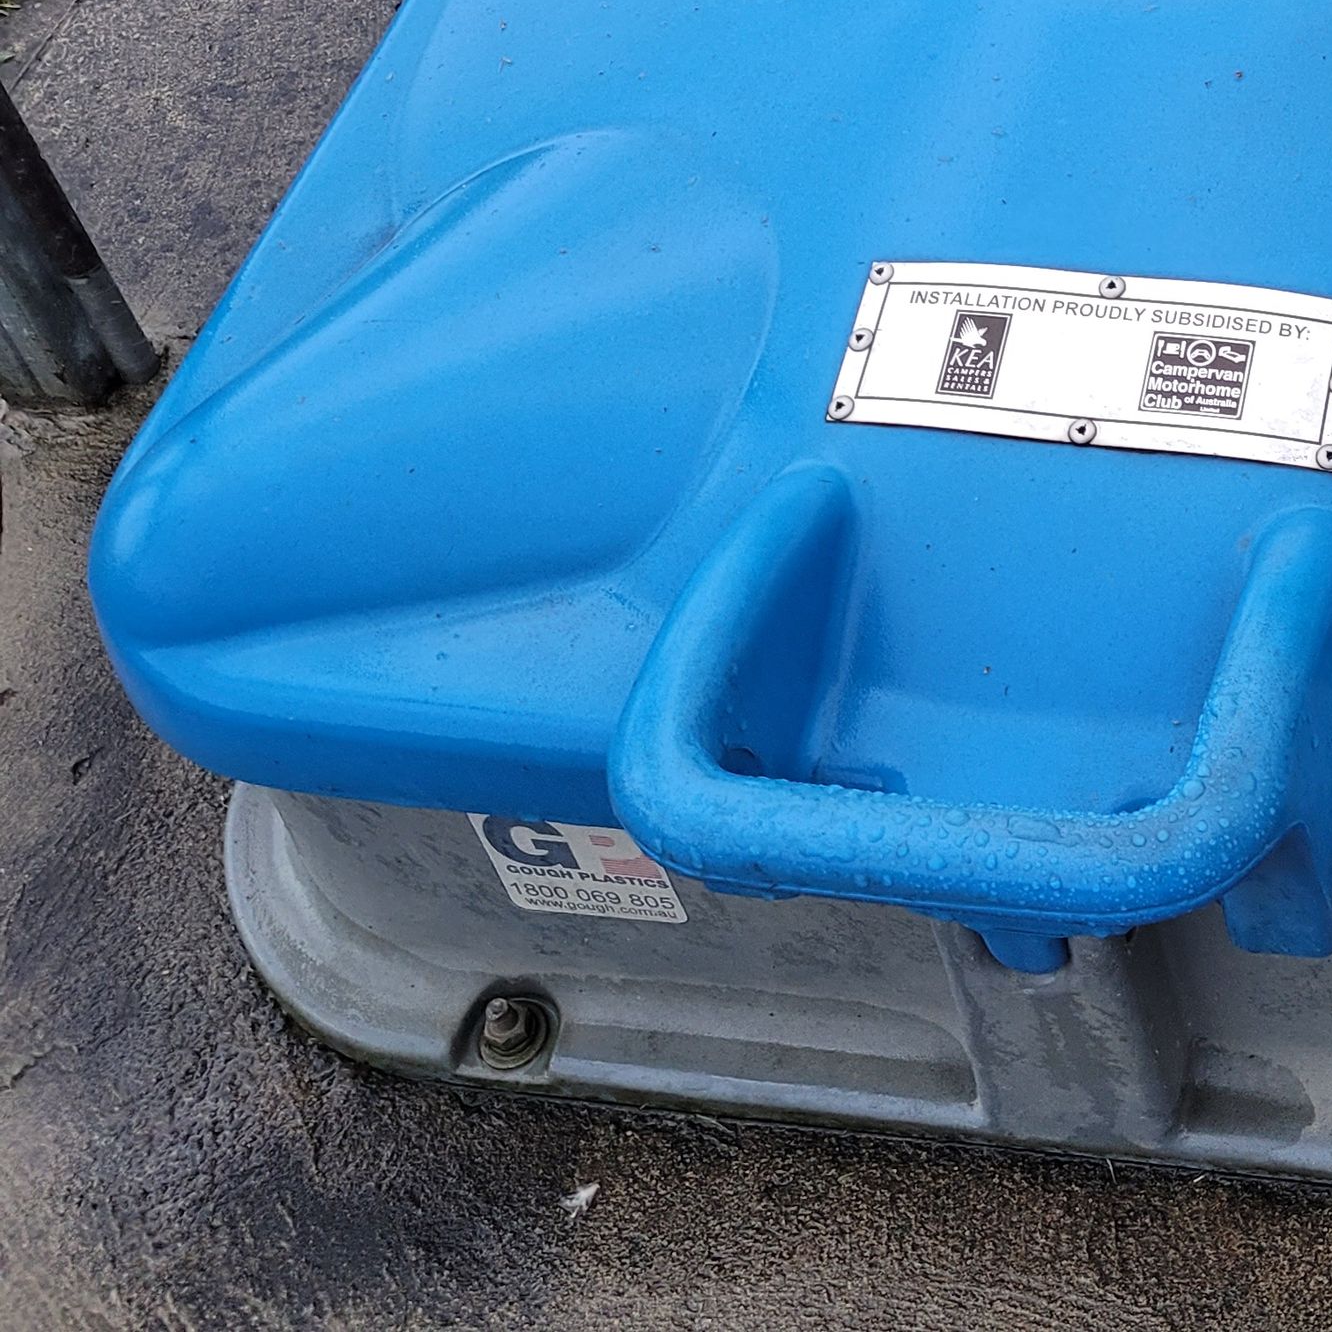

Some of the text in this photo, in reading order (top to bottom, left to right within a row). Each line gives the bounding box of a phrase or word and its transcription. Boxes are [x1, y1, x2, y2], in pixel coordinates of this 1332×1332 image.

[909, 290, 1310, 340] INSTALLATION PROUDLY SUBSIDISED BY:
[949, 348, 994, 369] KEA
[945, 374, 979, 384] SALES
[947, 367, 992, 377] CAMPERS
[1151, 360, 1244, 383] Campervan
[943, 382, 988, 392] RENTALS
[1147, 376, 1242, 399] Motorhome
[1144, 393, 1237, 410] Club of Australia
[506, 864, 669, 889] GOUGH PLASTICS
[510, 881, 676, 910] 1800 069 805
[525, 896, 677, 919] www.gough.com.au
